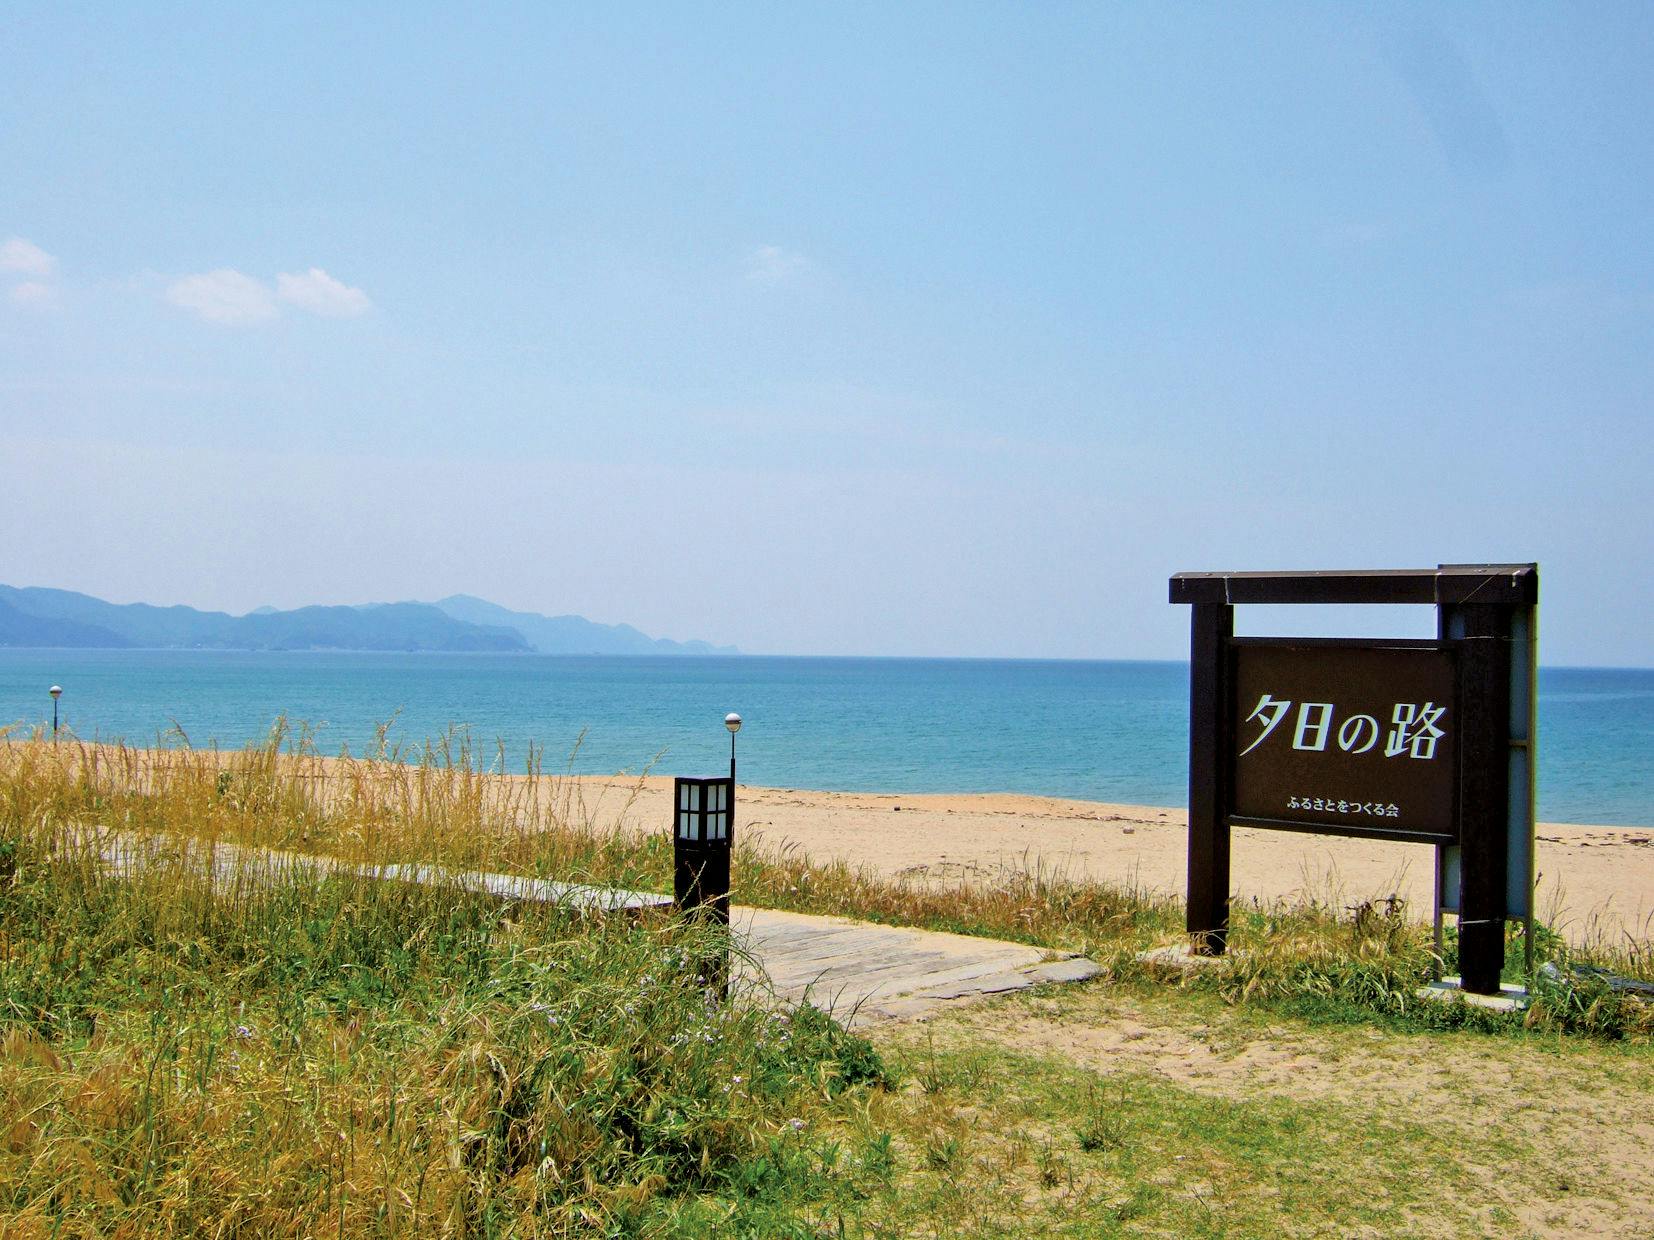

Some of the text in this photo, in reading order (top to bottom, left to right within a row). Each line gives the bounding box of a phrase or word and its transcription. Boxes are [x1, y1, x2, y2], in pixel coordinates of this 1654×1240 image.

[1239, 694, 1446, 760] 夕日の路
[1287, 796, 1399, 818] ふるさとをつくる会
